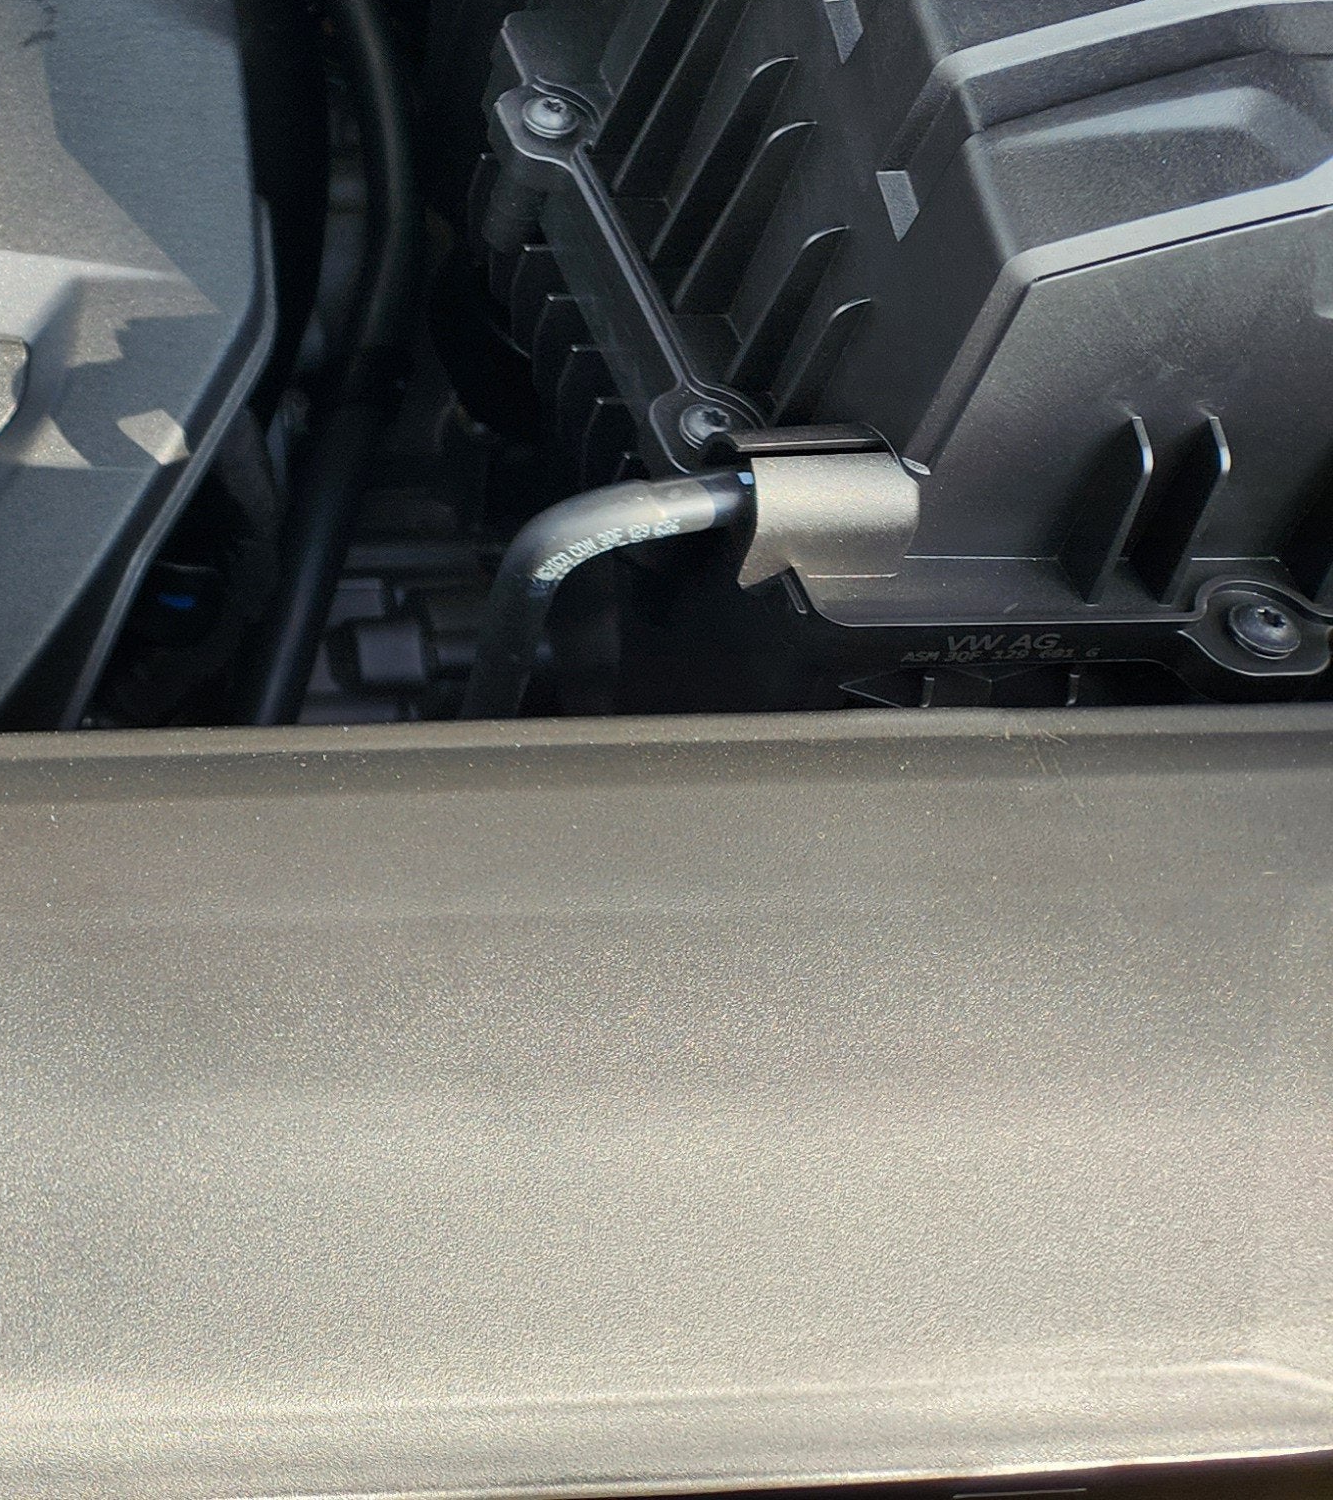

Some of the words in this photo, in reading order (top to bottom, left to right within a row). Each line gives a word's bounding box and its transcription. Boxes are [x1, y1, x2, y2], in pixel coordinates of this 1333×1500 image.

[946, 633, 1007, 651] VW
[1007, 632, 1062, 650] AG
[900, 650, 940, 663] ASM
